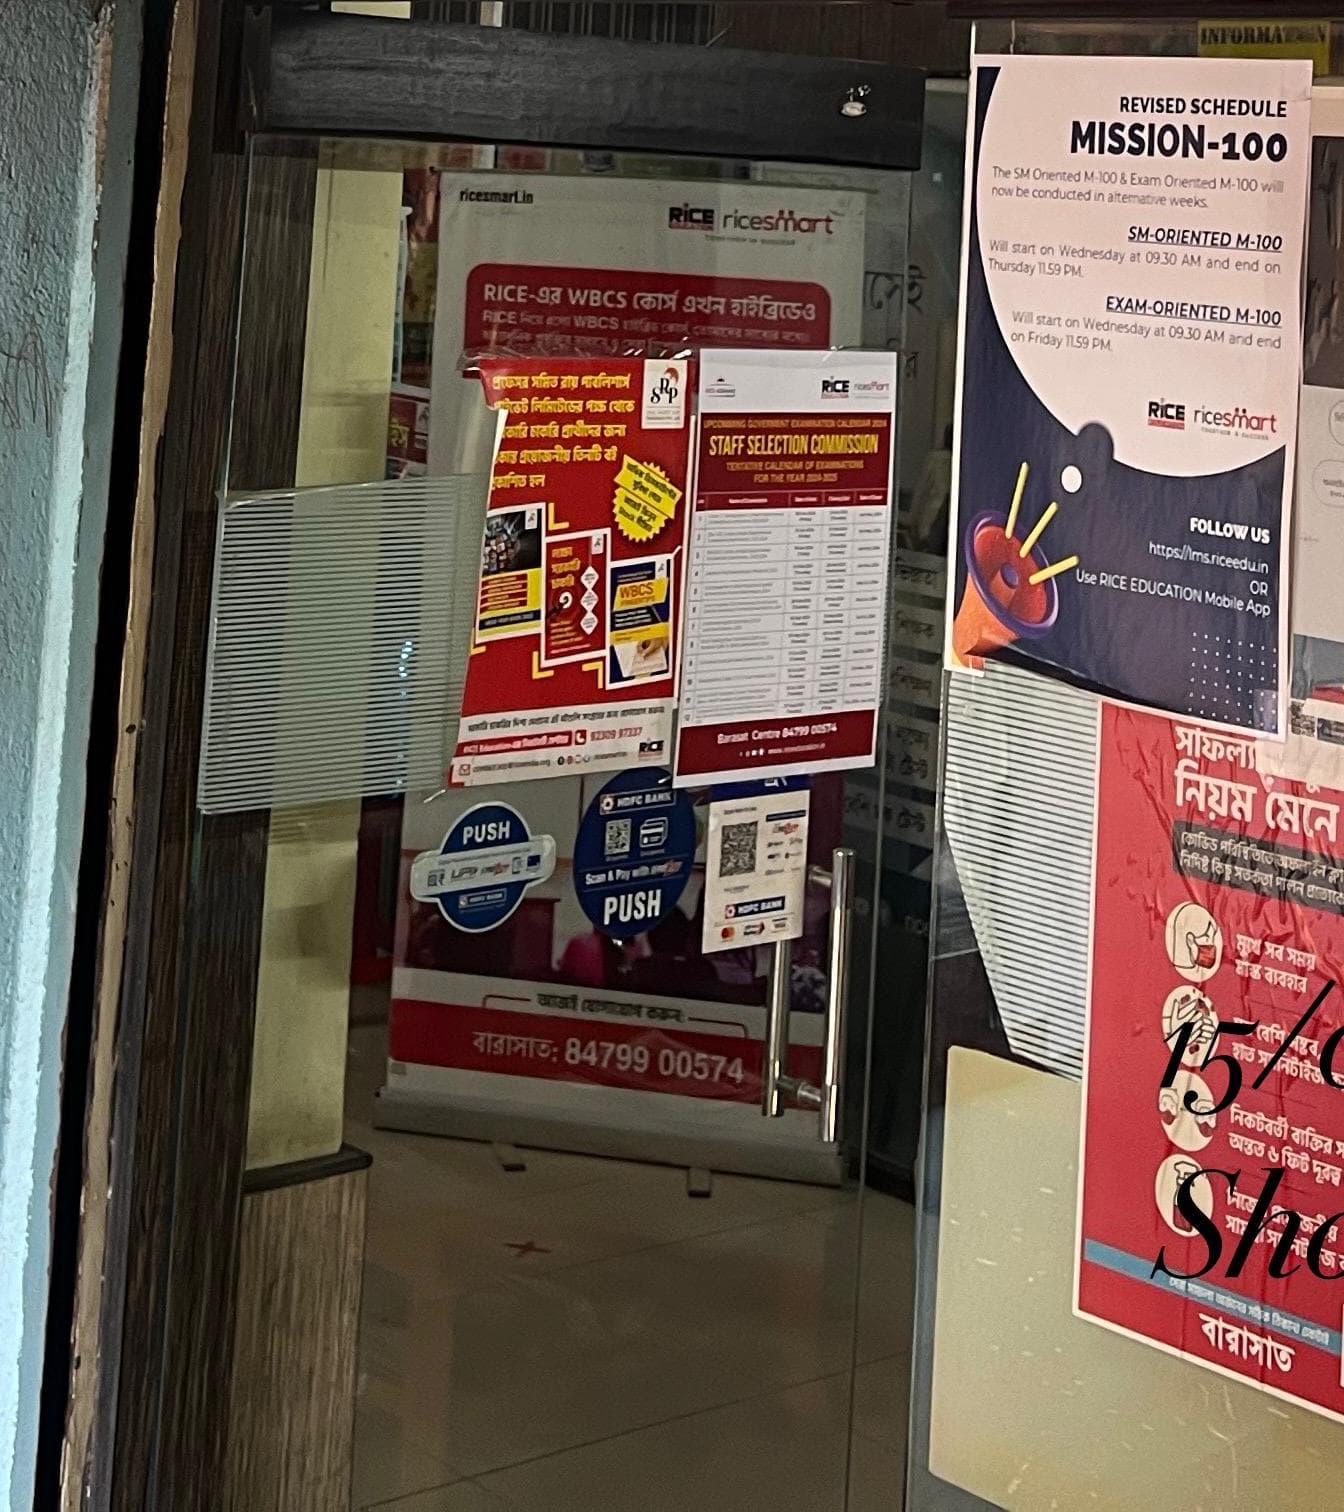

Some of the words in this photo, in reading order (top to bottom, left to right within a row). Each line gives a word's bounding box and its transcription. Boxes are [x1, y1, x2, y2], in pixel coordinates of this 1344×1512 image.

[1120, 96, 1186, 114] REVISED
[1190, 98, 1287, 118] SCHEDULE
[1071, 121, 1288, 162] MISSION-100
[992, 166, 1011, 179] The
[1013, 167, 1030, 180] SM
[1033, 167, 1081, 183] Oriented
[1084, 171, 1117, 184] M-100
[1130, 173, 1161, 187] Exam
[1164, 174, 1216, 189] Oriented
[1220, 178, 1258, 191] M-100
[992, 186, 1013, 197] now
[1015, 186, 1029, 198] be
[1032, 186, 1091, 201] conducted
[1128, 226, 1231, 248] SM-ORIENTED
[1236, 233, 1282, 250] M-100
[988, 258, 1035, 276] Thursday
[989, 240, 1008, 253] Will
[1012, 243, 1036, 255] start
[1040, 245, 1054, 255] on
[1059, 244, 1125, 264] Wednesday
[1130, 251, 1141, 262] at
[1181, 254, 1201, 267] AM
[1206, 256, 1230, 270] and
[1235, 258, 1259, 272] end
[1264, 262, 1281, 273] on
[568, 289, 627, 309] WBCS
[1106, 296, 1231, 321] EXAM-ORIENTED
[1235, 308, 1281, 326] M-100
[709, 435, 745, 456] STAFF
[747, 434, 808, 455] SELECTION
[811, 434, 879, 454] COMMISSION
[1190, 517, 1249, 540] FOLLOW
[1251, 527, 1270, 544] US
[1076, 569, 1097, 586] Use
[1100, 572, 1128, 590] RICE
[1130, 576, 1203, 603] EDUCATION
[1205, 588, 1244, 611] Mobile
[1246, 598, 1271, 618] App
[1250, 581, 1268, 597] OR
[1174, 758, 1258, 823] নিয়ম
[1264, 790, 1341, 843] মেনে
[462, 821, 511, 845] PUSH
[604, 889, 661, 925] PUSH
[564, 1037, 650, 1073] 84799
[658, 1049, 744, 1084] 00574
[1198, 1312, 1296, 1372] বারাসাত
